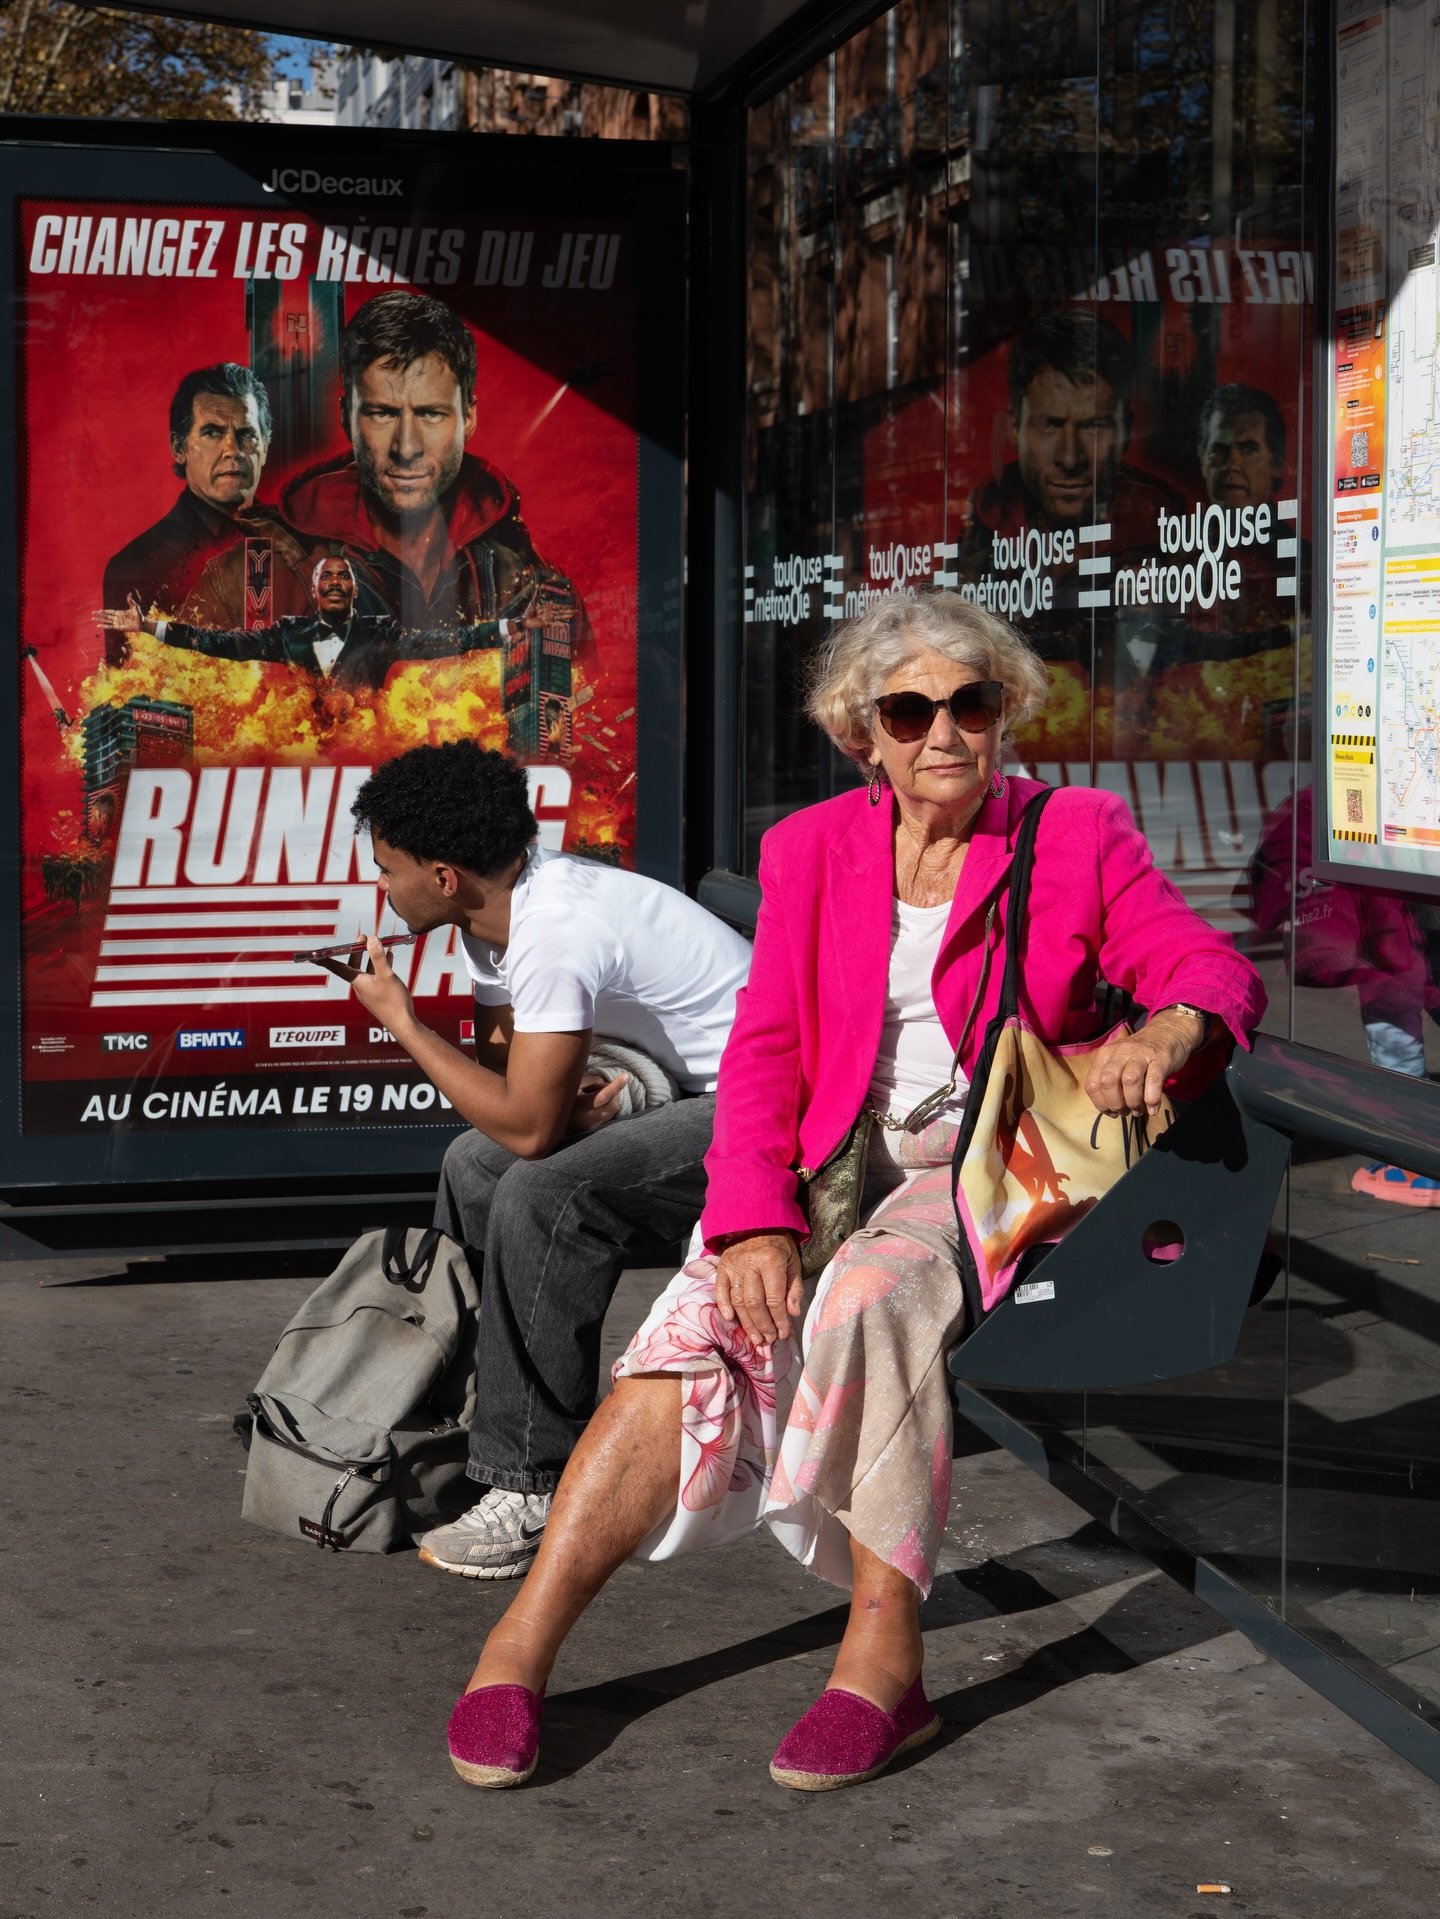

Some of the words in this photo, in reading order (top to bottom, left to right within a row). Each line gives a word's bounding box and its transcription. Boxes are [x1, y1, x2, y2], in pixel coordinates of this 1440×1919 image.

[262, 168, 403, 197] JCDecaux
[29, 214, 226, 279] CHANGEZ
[233, 221, 307, 281] LES
[316, 215, 465, 286] RÈGLES
[474, 229, 535, 288] DU
[541, 232, 621, 290] JEU
[992, 526, 1075, 576] toulouse
[1157, 502, 1272, 562] toulouse
[773, 553, 822, 592] toulouse
[869, 542, 932, 586] toulouse
[1114, 552, 1241, 614] métropole
[754, 588, 810, 628] métropole
[112, 766, 572, 887] RUNNG
[103, 1034, 148, 1050] TMC
[180, 1031, 243, 1048] BFMTV.
[274, 1029, 341, 1043] L'ÉQUIPE
[80, 1093, 131, 1122] AU
[142, 1081, 282, 1119] CINÉMA
[292, 1086, 331, 1114] LE
[339, 1084, 373, 1111] 19
